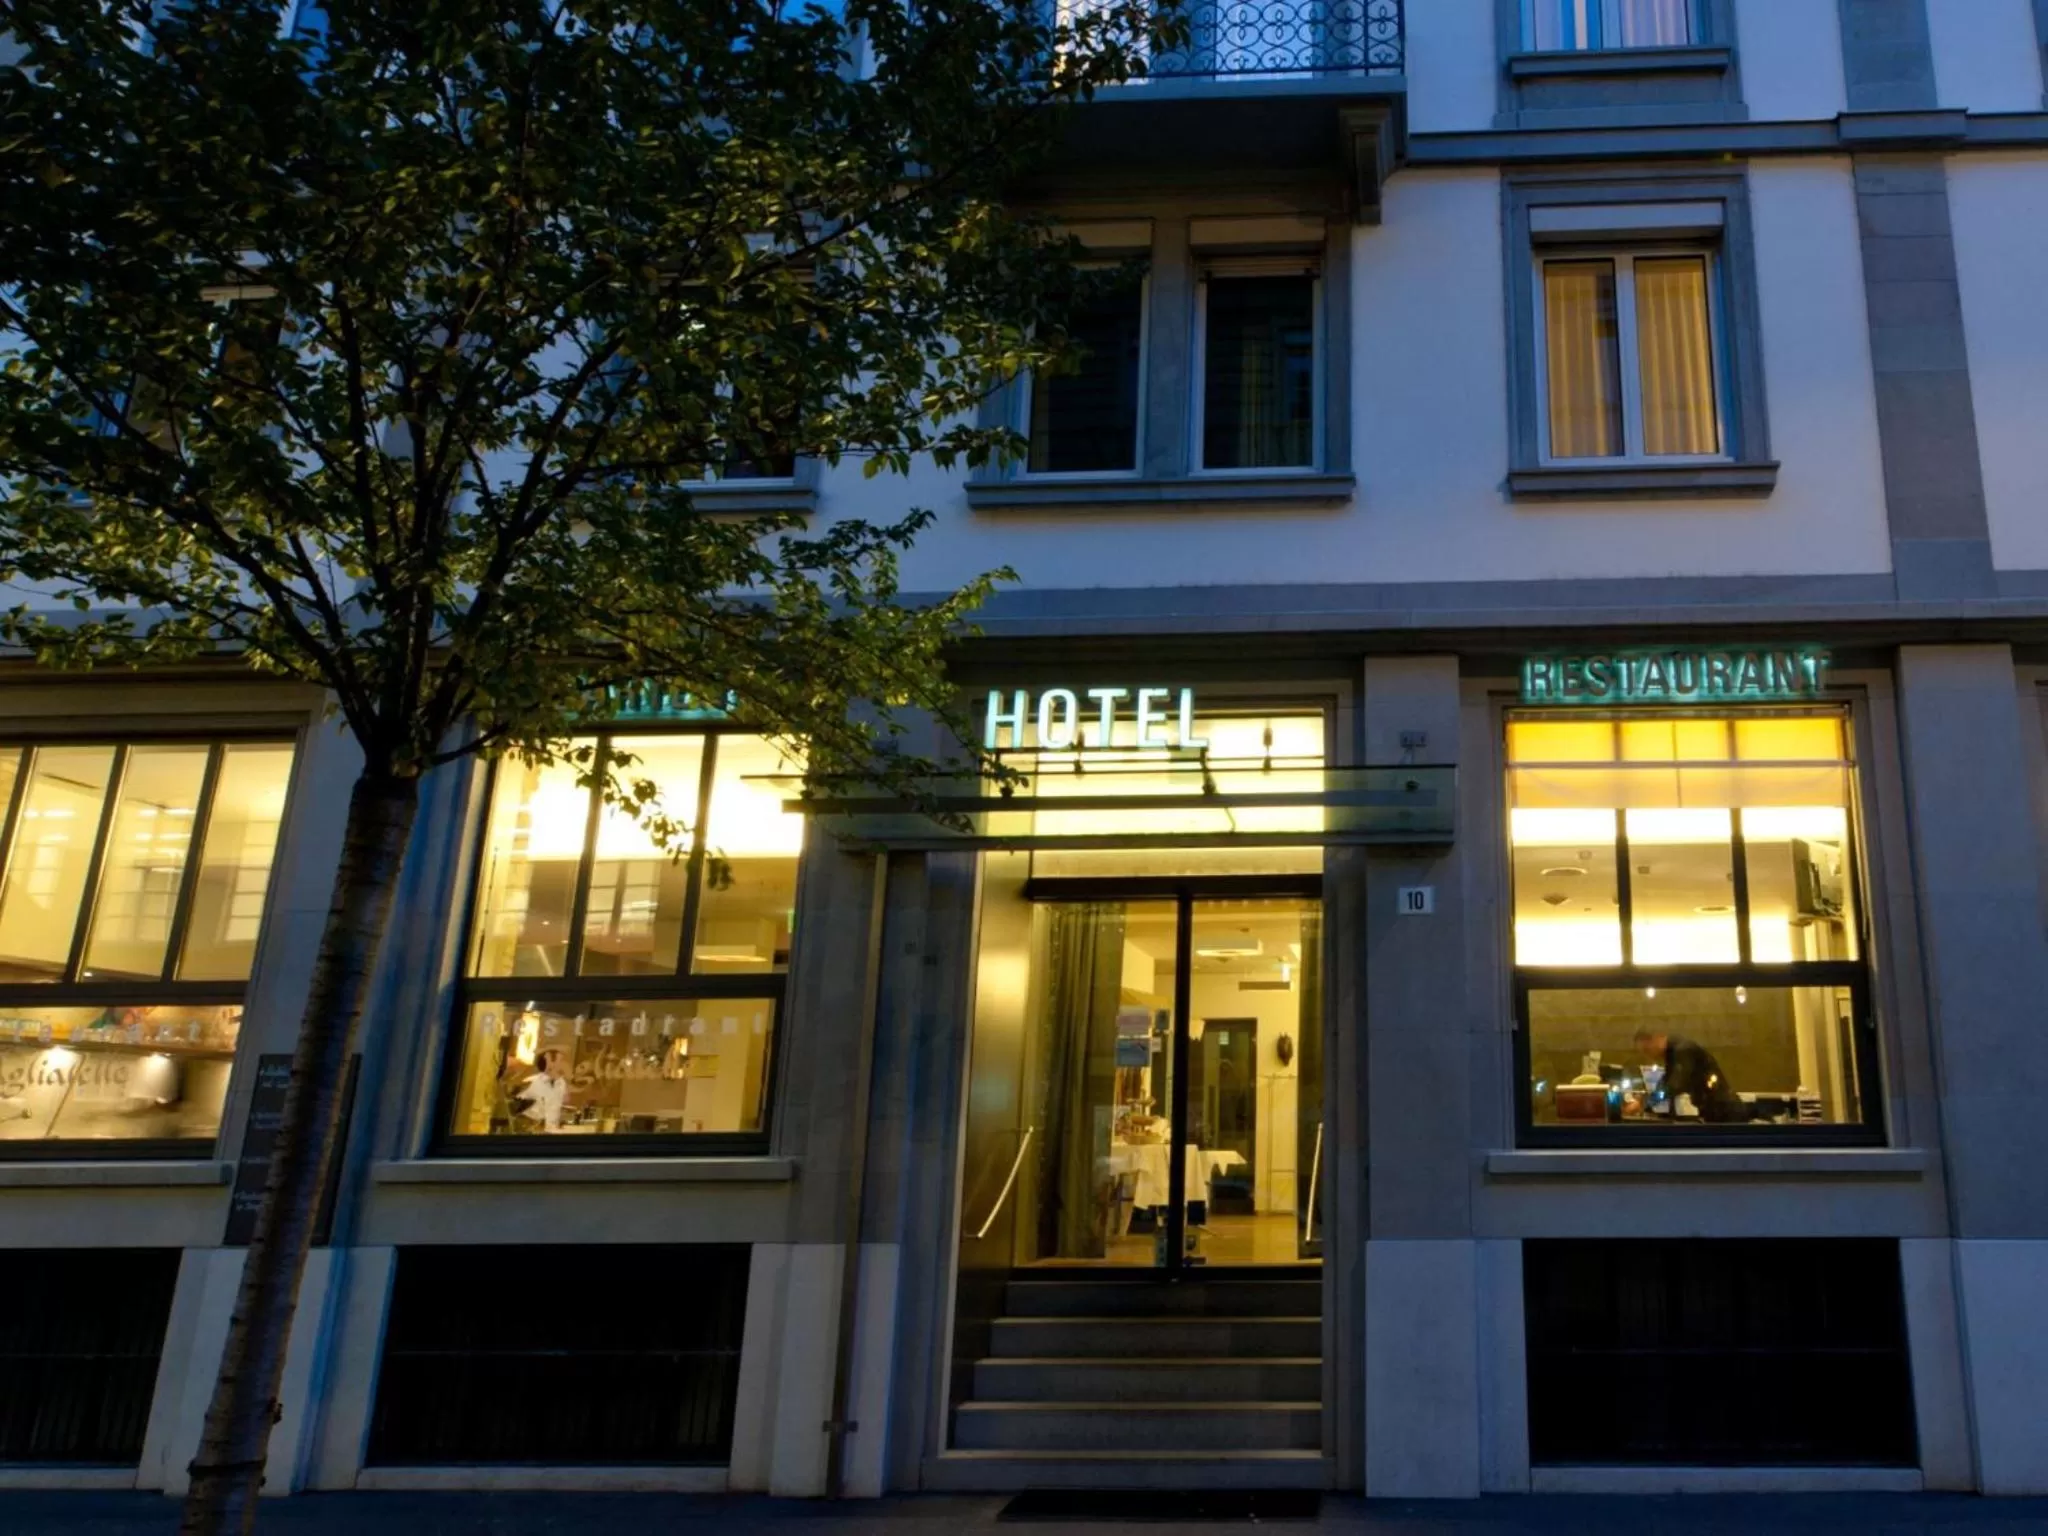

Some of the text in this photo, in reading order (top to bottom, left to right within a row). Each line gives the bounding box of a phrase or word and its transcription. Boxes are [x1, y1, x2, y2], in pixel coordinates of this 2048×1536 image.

[1525, 652, 1832, 699] RESTAURANT
[985, 688, 1210, 750] HOTEL
[1407, 891, 1425, 910] 10
